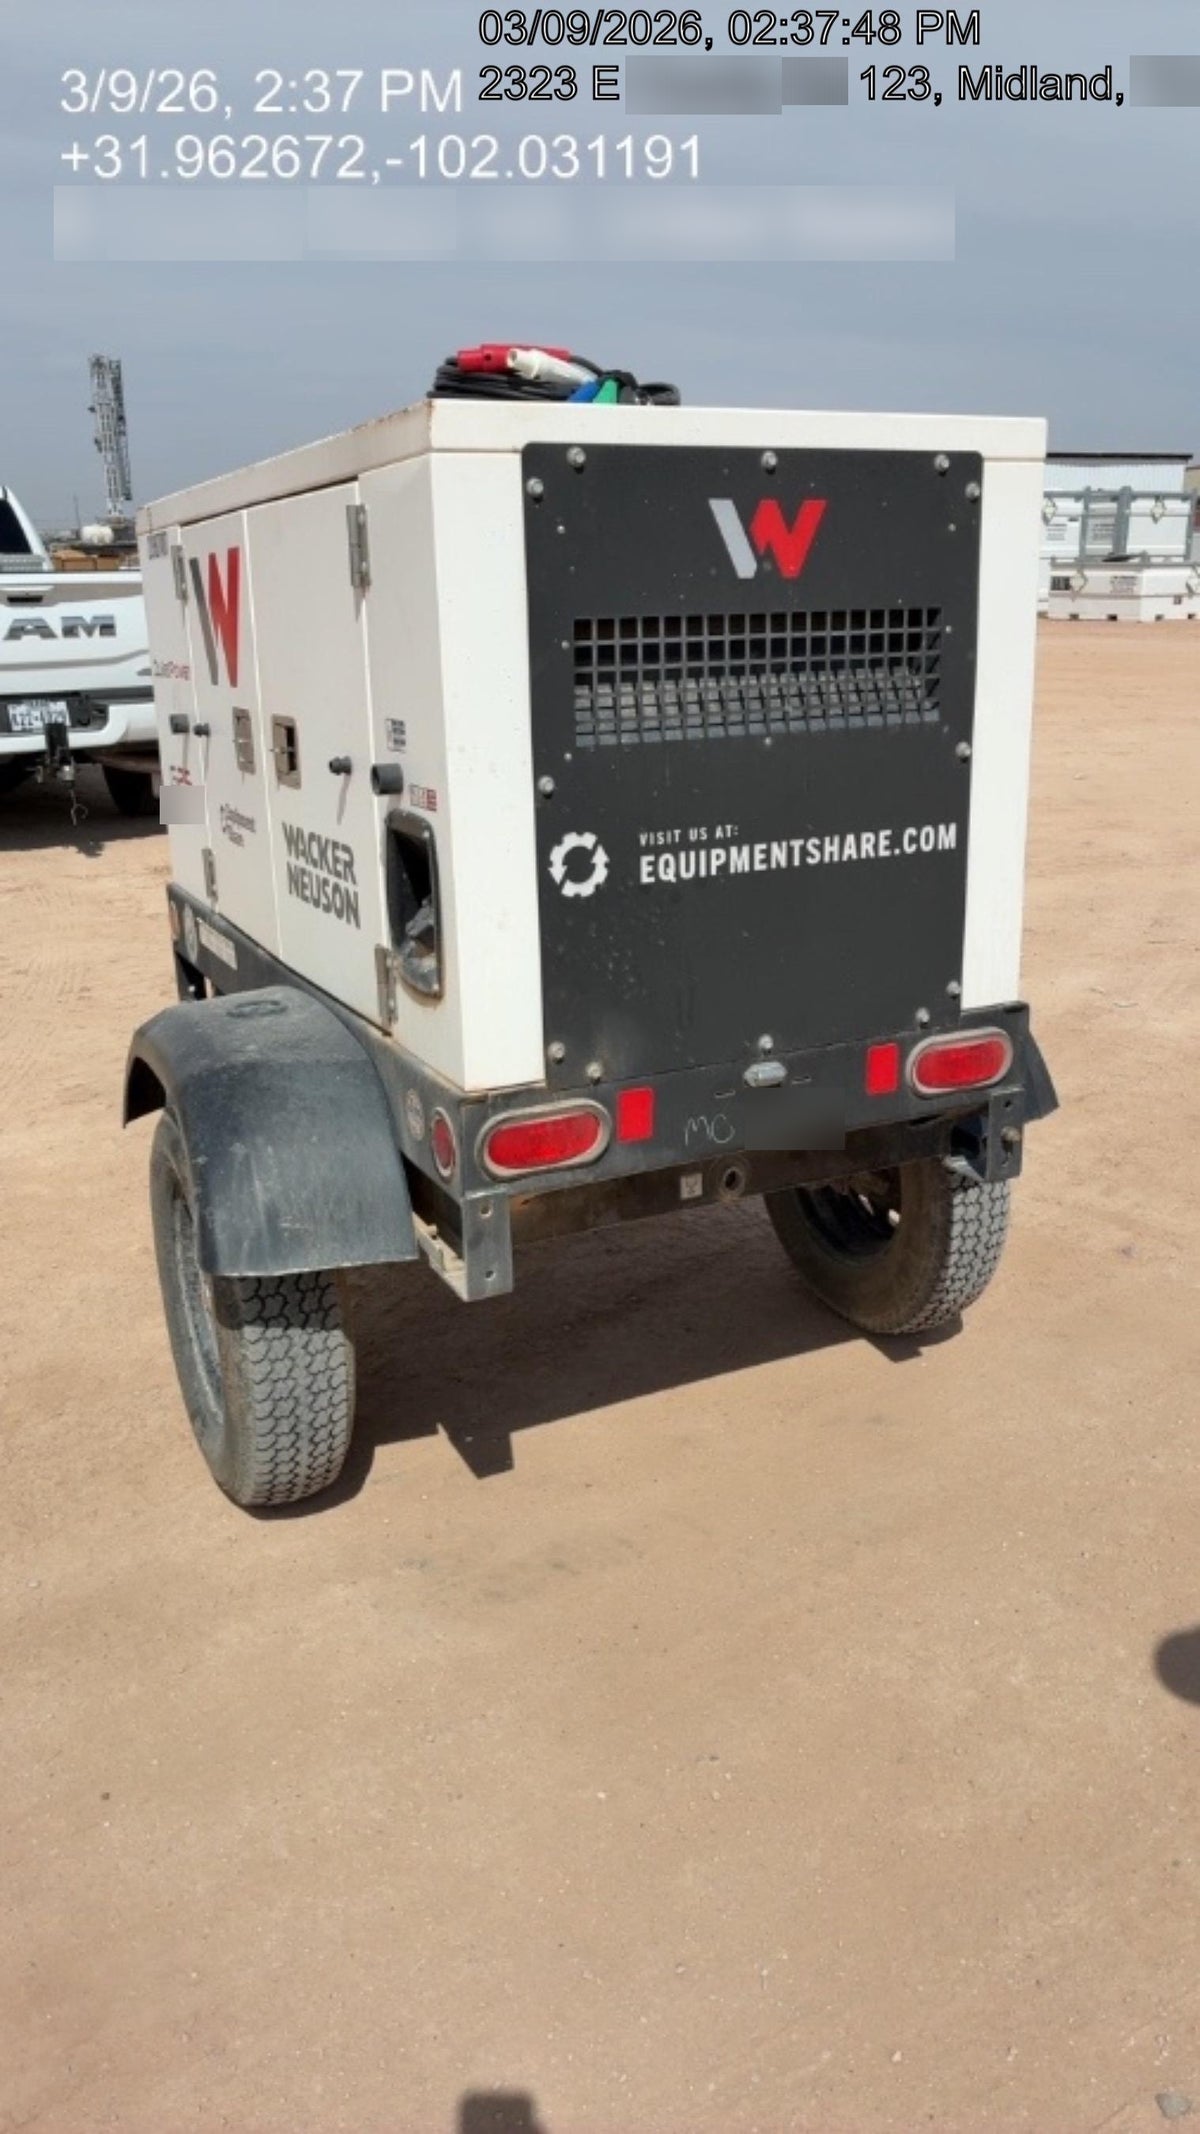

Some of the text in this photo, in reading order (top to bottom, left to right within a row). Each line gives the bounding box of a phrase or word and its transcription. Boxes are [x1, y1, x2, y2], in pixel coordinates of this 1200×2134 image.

[281, 820, 358, 885] WACKER
[639, 824, 739, 847] VISIT US AT:
[639, 822, 958, 884] EQUIPMENTSHARE.COM
[286, 860, 361, 930] NEUSON
